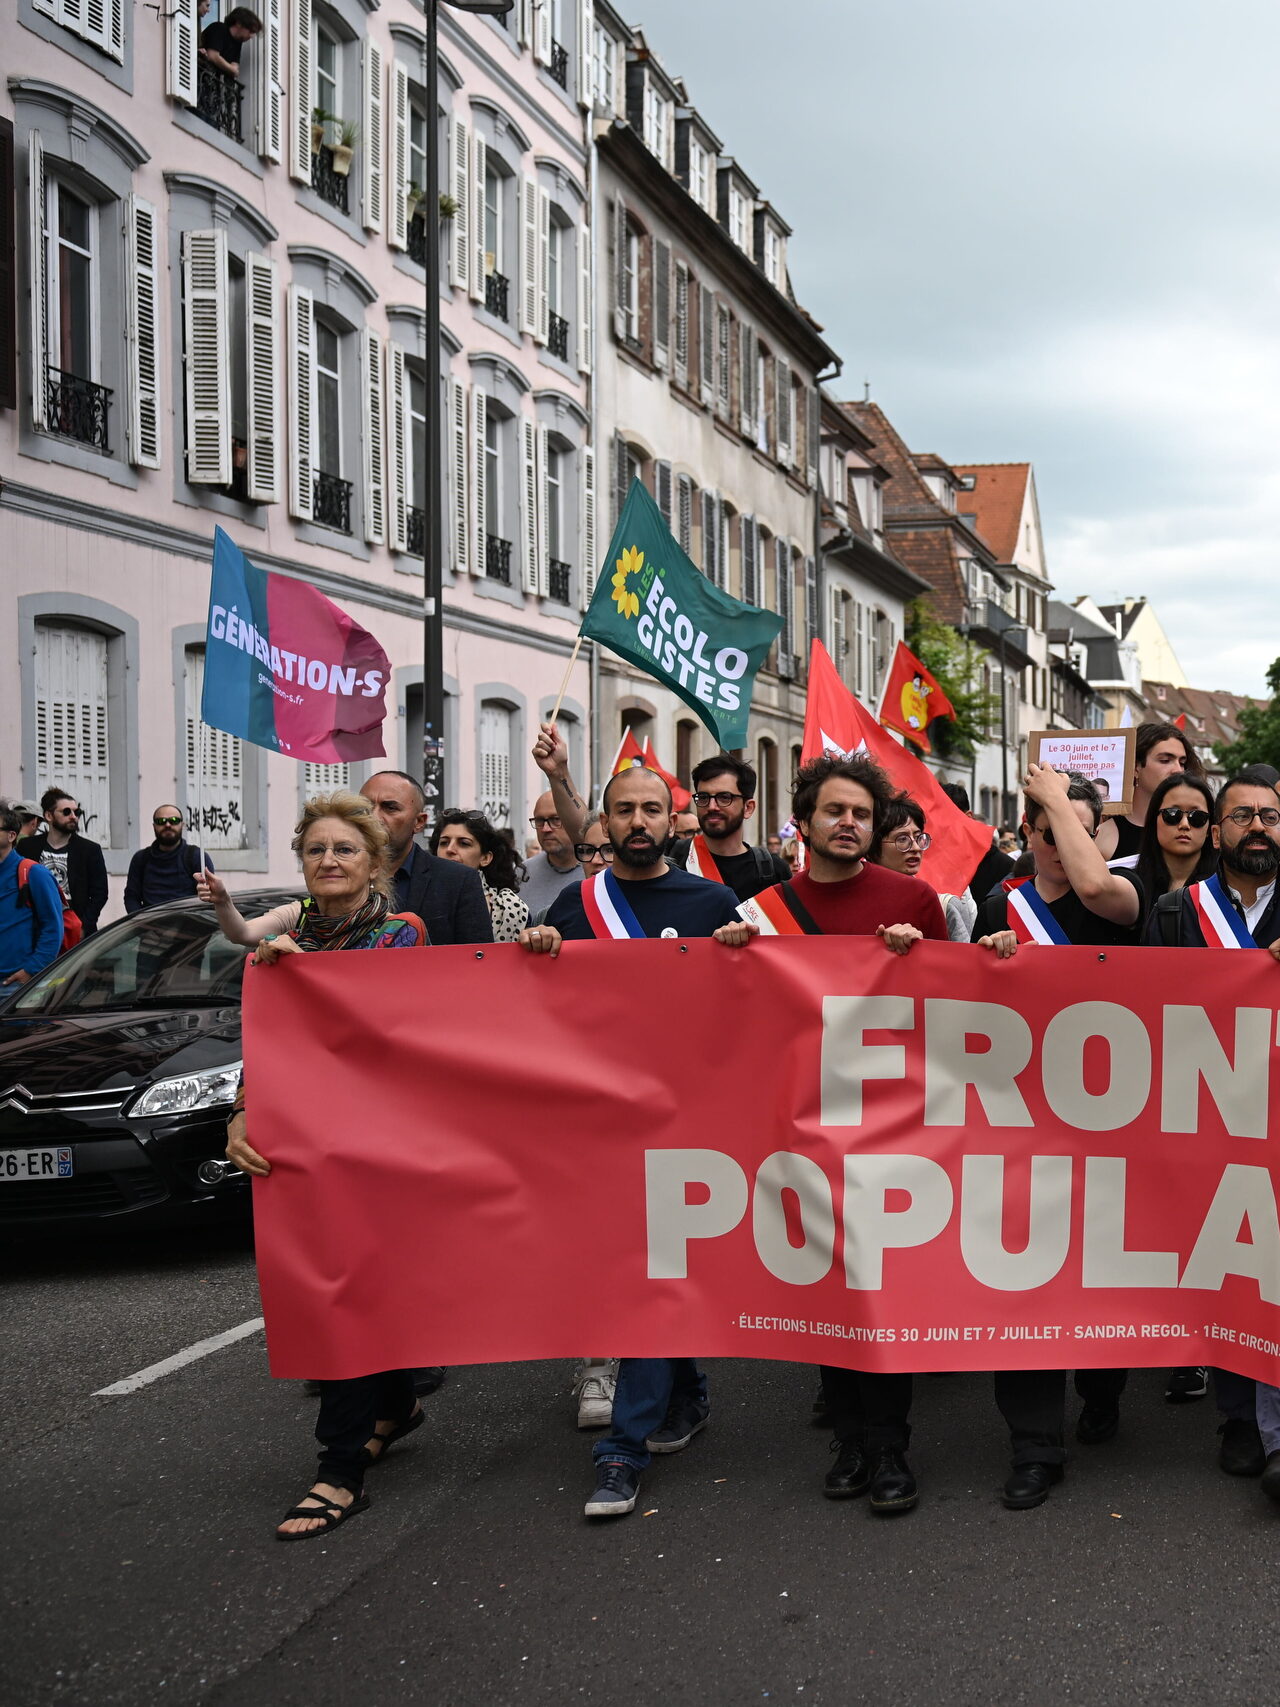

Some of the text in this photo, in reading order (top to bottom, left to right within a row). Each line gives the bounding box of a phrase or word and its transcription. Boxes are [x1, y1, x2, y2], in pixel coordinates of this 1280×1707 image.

[637, 562, 655, 600] LES
[637, 614, 741, 711] GISTES
[1049, 745, 1058, 753] Le
[1073, 744, 1089, 754] juin
[1091, 744, 1099, 752] et
[1101, 744, 1109, 752] le
[1111, 743, 1116, 752] 7
[1069, 762, 1099, 771] trompe
[1101, 762, 1116, 771] pas
[58, 1163, 71, 1175] 67
[739, 1312, 807, 1333] ÉLECTIONS
[809, 1321, 897, 1343] LEGISLATIVES
[900, 1327, 919, 1342] 30
[923, 1327, 960, 1342] JUIN
[963, 1326, 984, 1341] ET
[986, 1326, 996, 1341] 7
[999, 1325, 1063, 1341] JUILLET
[1073, 1324, 1137, 1339] SANDRA
[1140, 1324, 1191, 1338] REGOL
[1203, 1322, 1237, 1343] 1ÈRE
